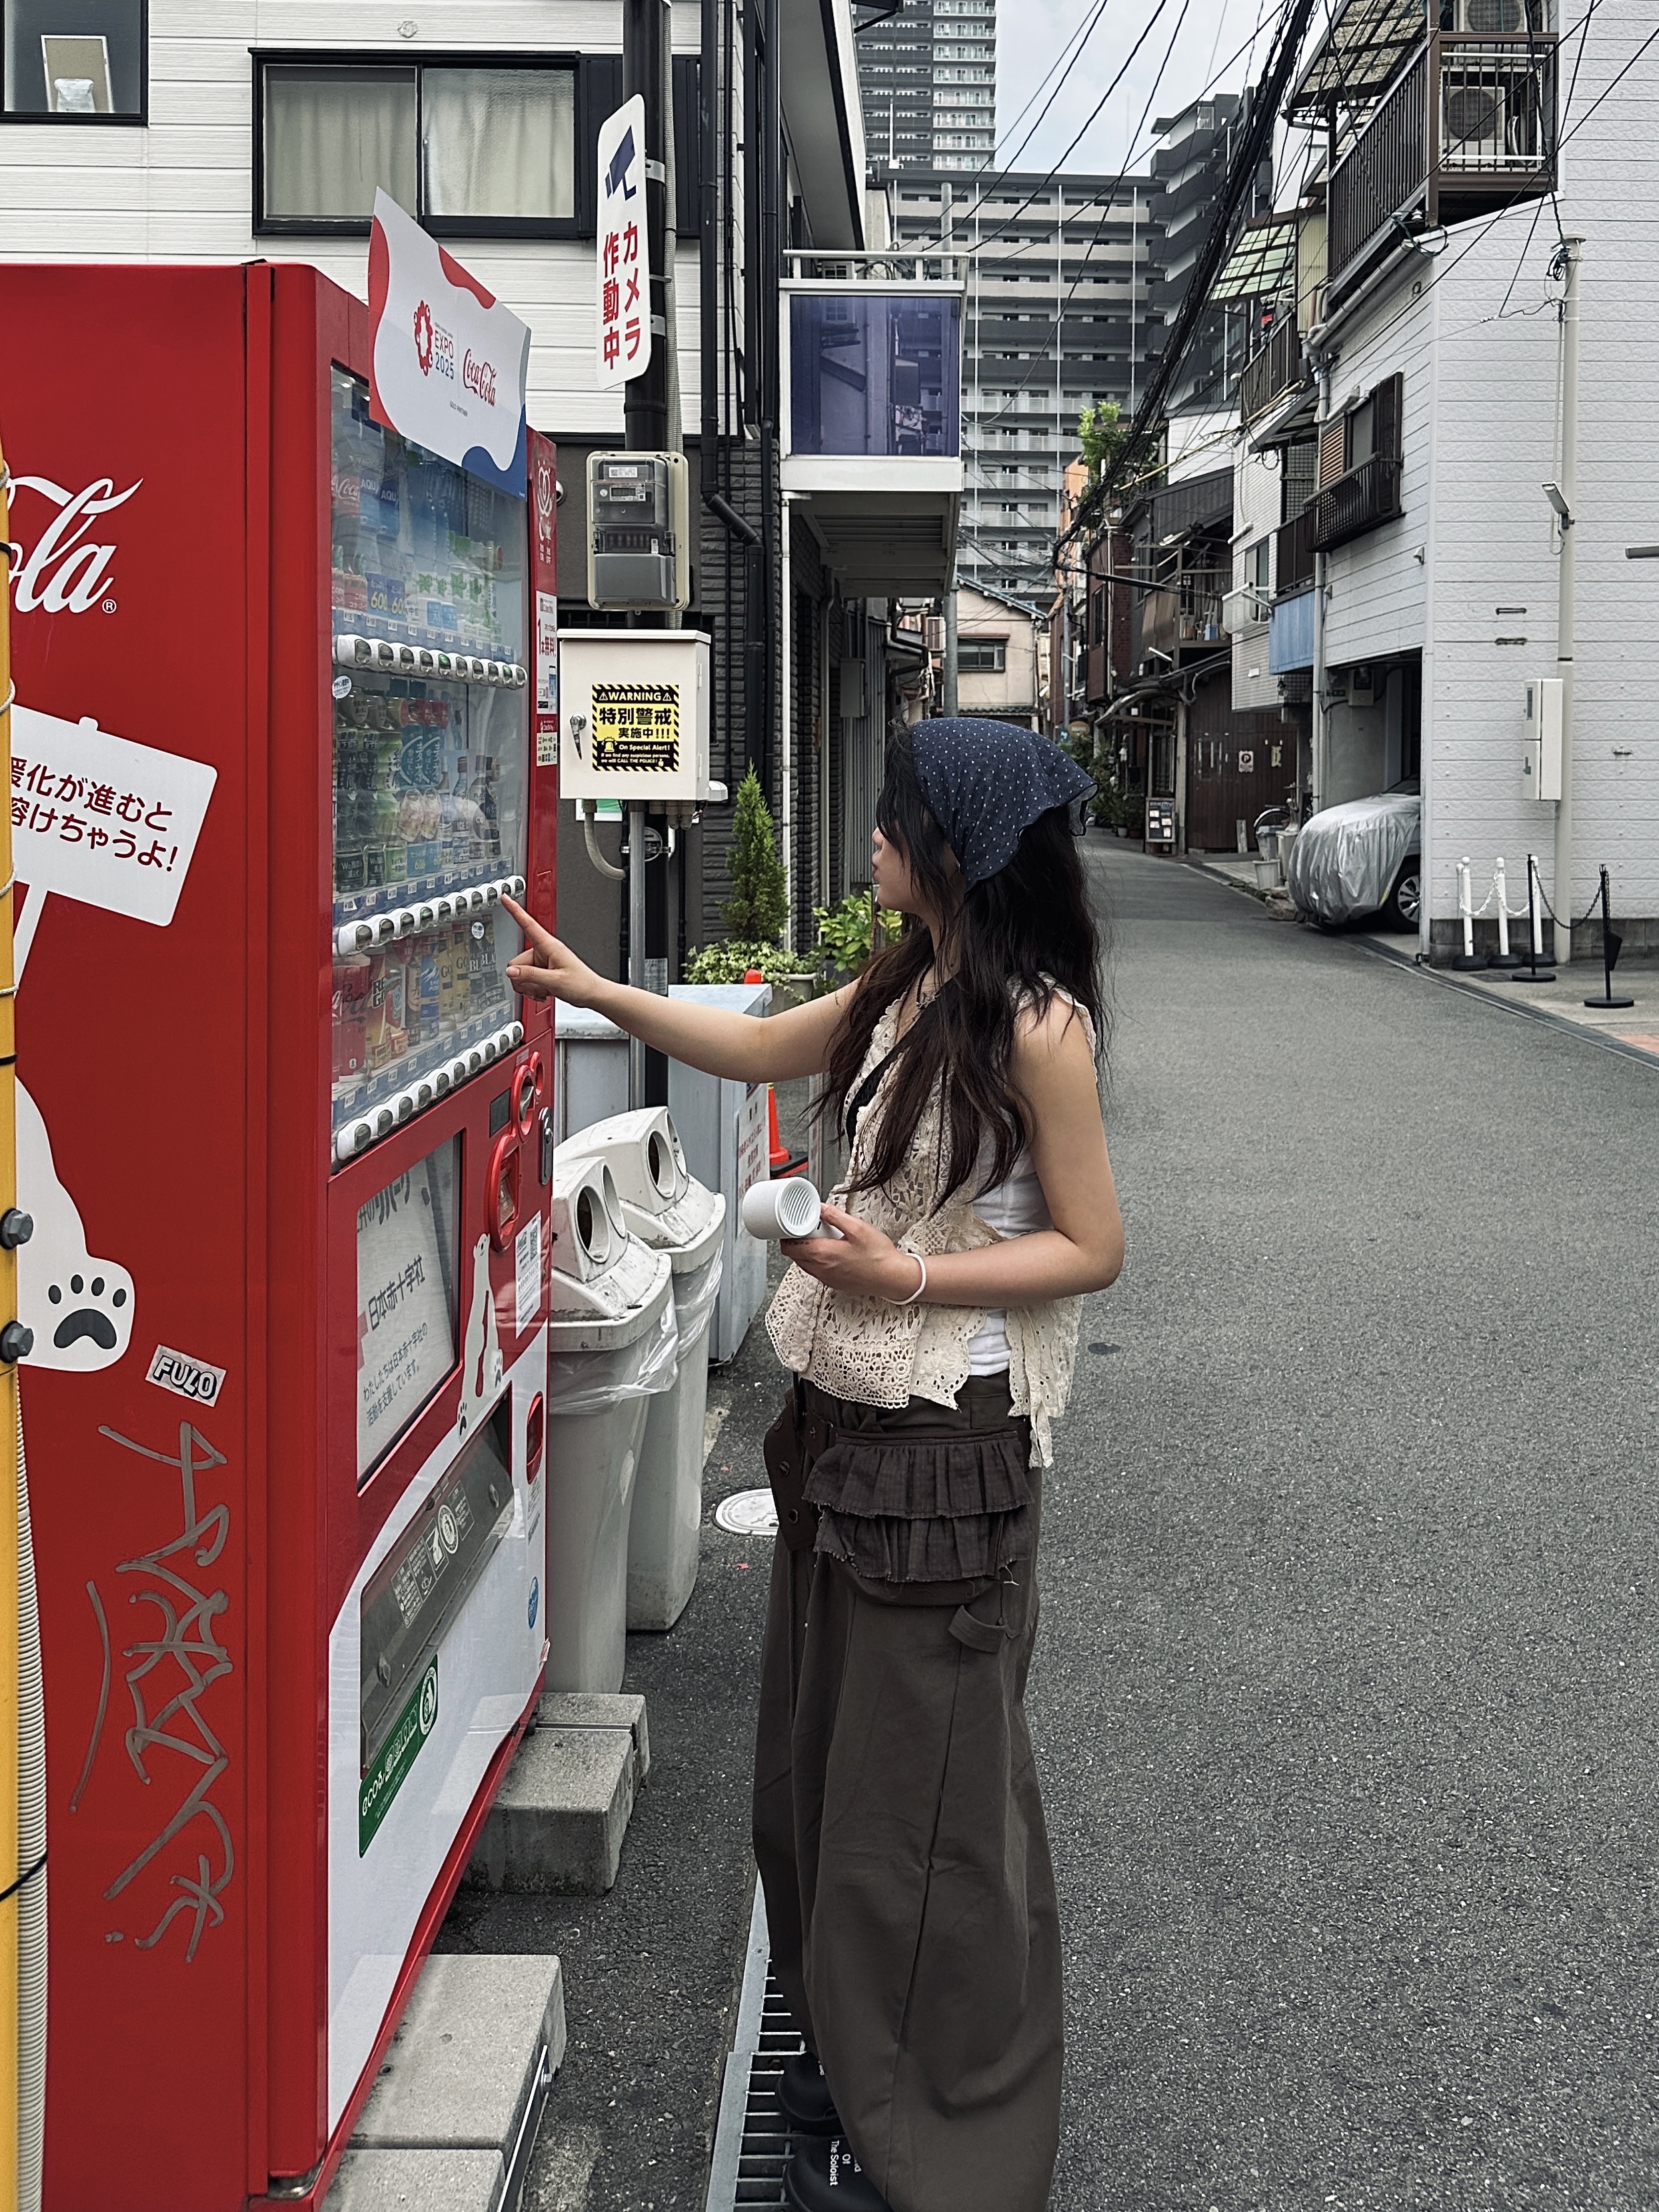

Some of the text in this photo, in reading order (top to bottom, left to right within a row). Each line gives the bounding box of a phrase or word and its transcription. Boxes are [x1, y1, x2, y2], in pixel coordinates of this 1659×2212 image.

[603, 231, 620, 370] 作動中
[623, 220, 641, 361] カメラ
[435, 330, 454, 359] EXPO
[435, 351, 454, 380] 2025
[599, 707, 672, 725] 特別警戒
[608, 692, 661, 701] WARNING
[415, 741, 423, 783] 麦茶
[369, 1254, 425, 1331] 日本赤十字社
[153, 1355, 217, 1399] FULO
[363, 1323, 428, 1401] わたしたちは日本赤十字社の
[829, 2139, 840, 2186] The Soloist
